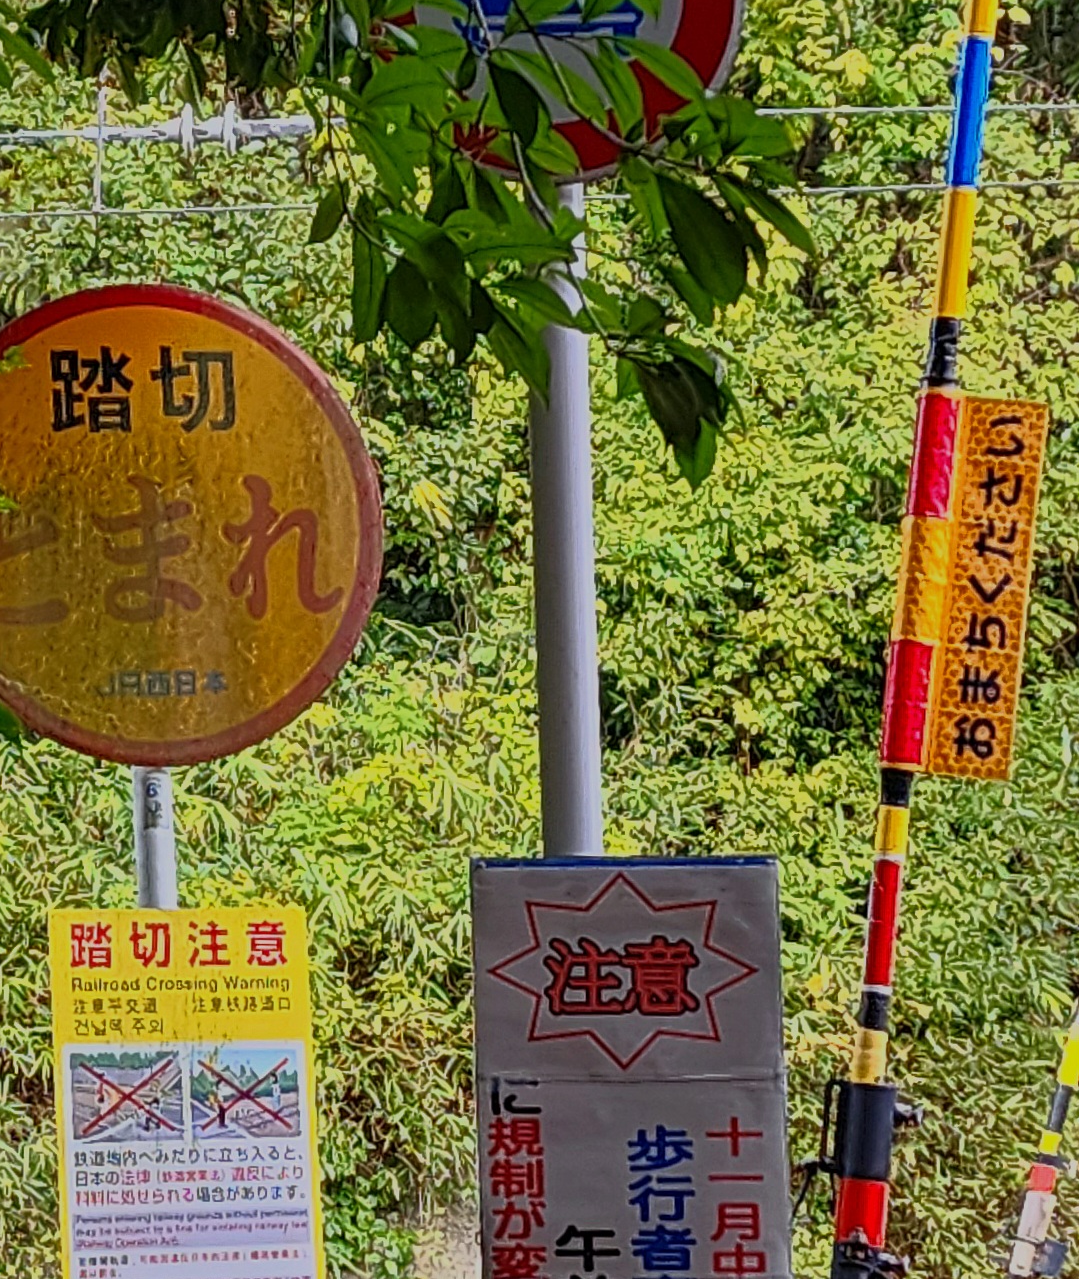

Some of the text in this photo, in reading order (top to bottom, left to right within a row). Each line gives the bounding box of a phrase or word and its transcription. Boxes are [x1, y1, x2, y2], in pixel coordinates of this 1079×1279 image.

[50, 345, 236, 433] 踏切
[952, 415, 1025, 760] おまちください
[70, 921, 288, 969] 踏切注意
[71, 975, 290, 993] Railroad Crossing Warning
[544, 935, 700, 1016] 注意
